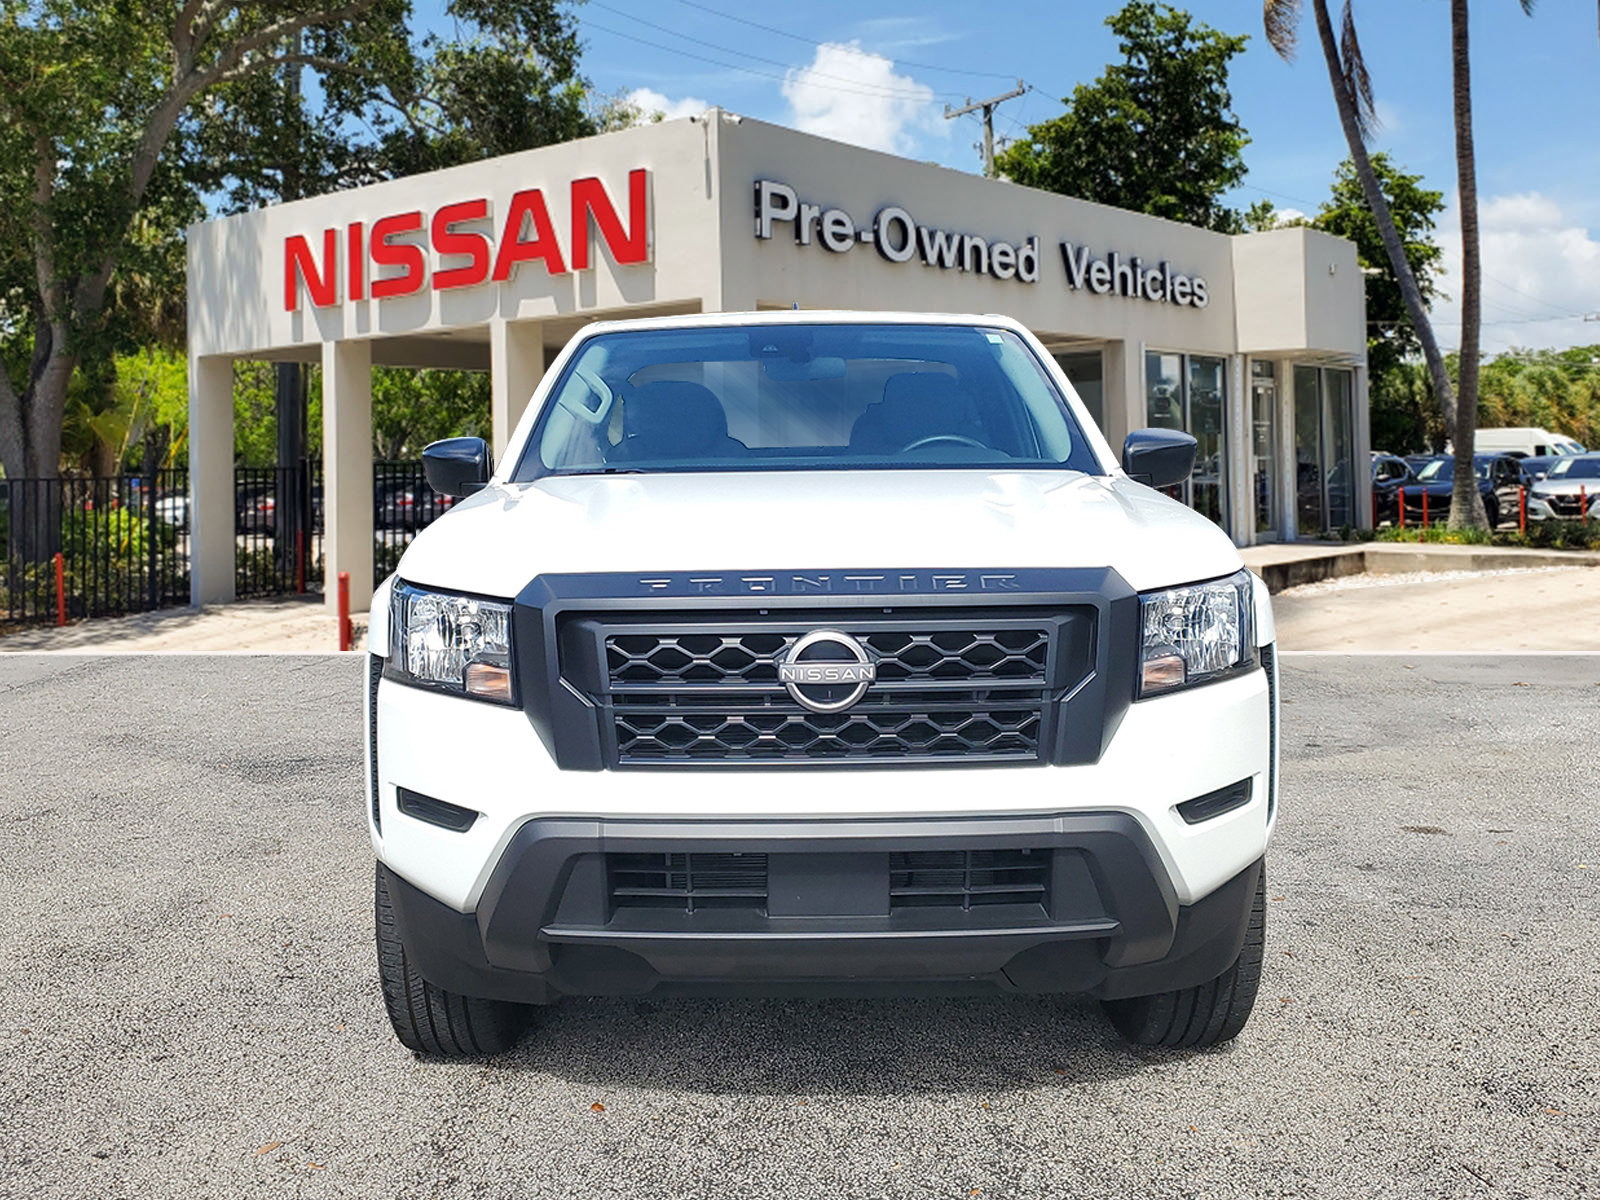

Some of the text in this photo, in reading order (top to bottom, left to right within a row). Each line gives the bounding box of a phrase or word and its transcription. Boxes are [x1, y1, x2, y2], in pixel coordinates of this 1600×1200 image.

[284, 168, 650, 312] NISSAN
[754, 180, 1209, 308] Pre-Owned Vehicles
[639, 575, 1021, 593] FRONTIER
[781, 666, 875, 682] NISSAN
